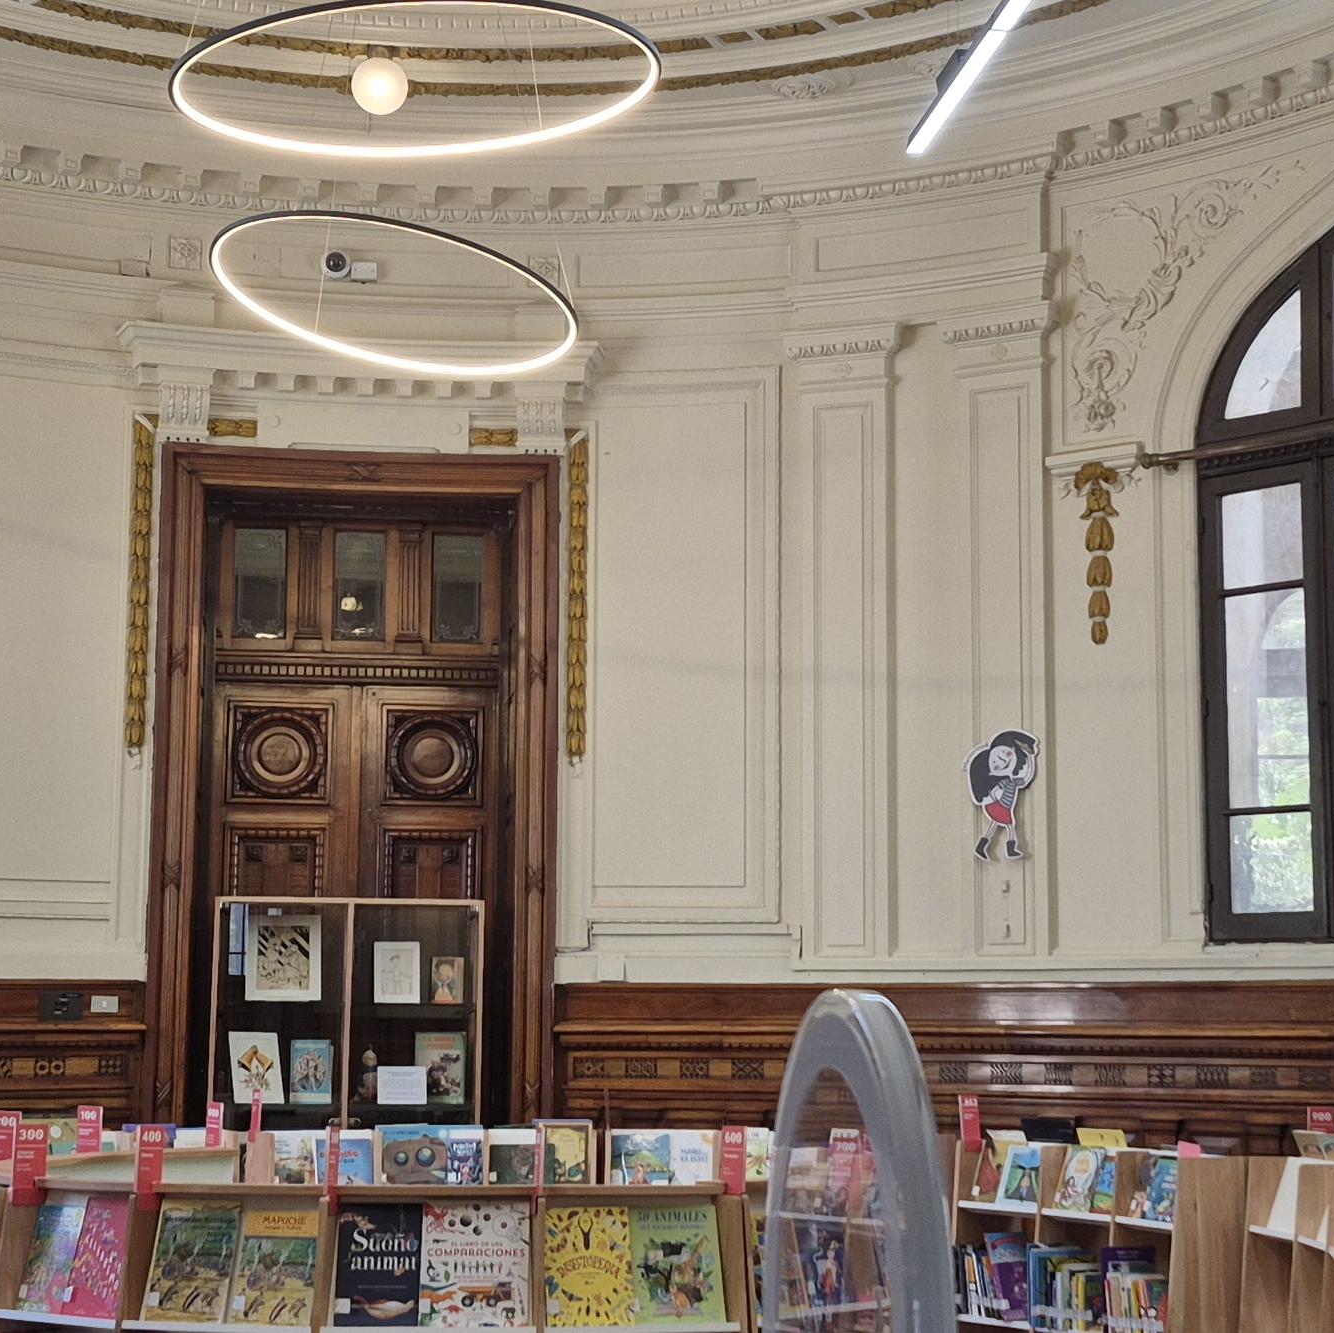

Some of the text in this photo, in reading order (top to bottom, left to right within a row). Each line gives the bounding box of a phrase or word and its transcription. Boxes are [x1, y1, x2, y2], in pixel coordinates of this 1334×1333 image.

[80, 1110, 97, 1121] 100
[18, 1129, 44, 1141] 300
[142, 1130, 162, 1142] 400
[724, 1131, 743, 1145] 600
[262, 1215, 307, 1226] MAPUCHE
[654, 1210, 708, 1223] ANIMALES
[427, 1247, 526, 1257] COMPARACIONES
